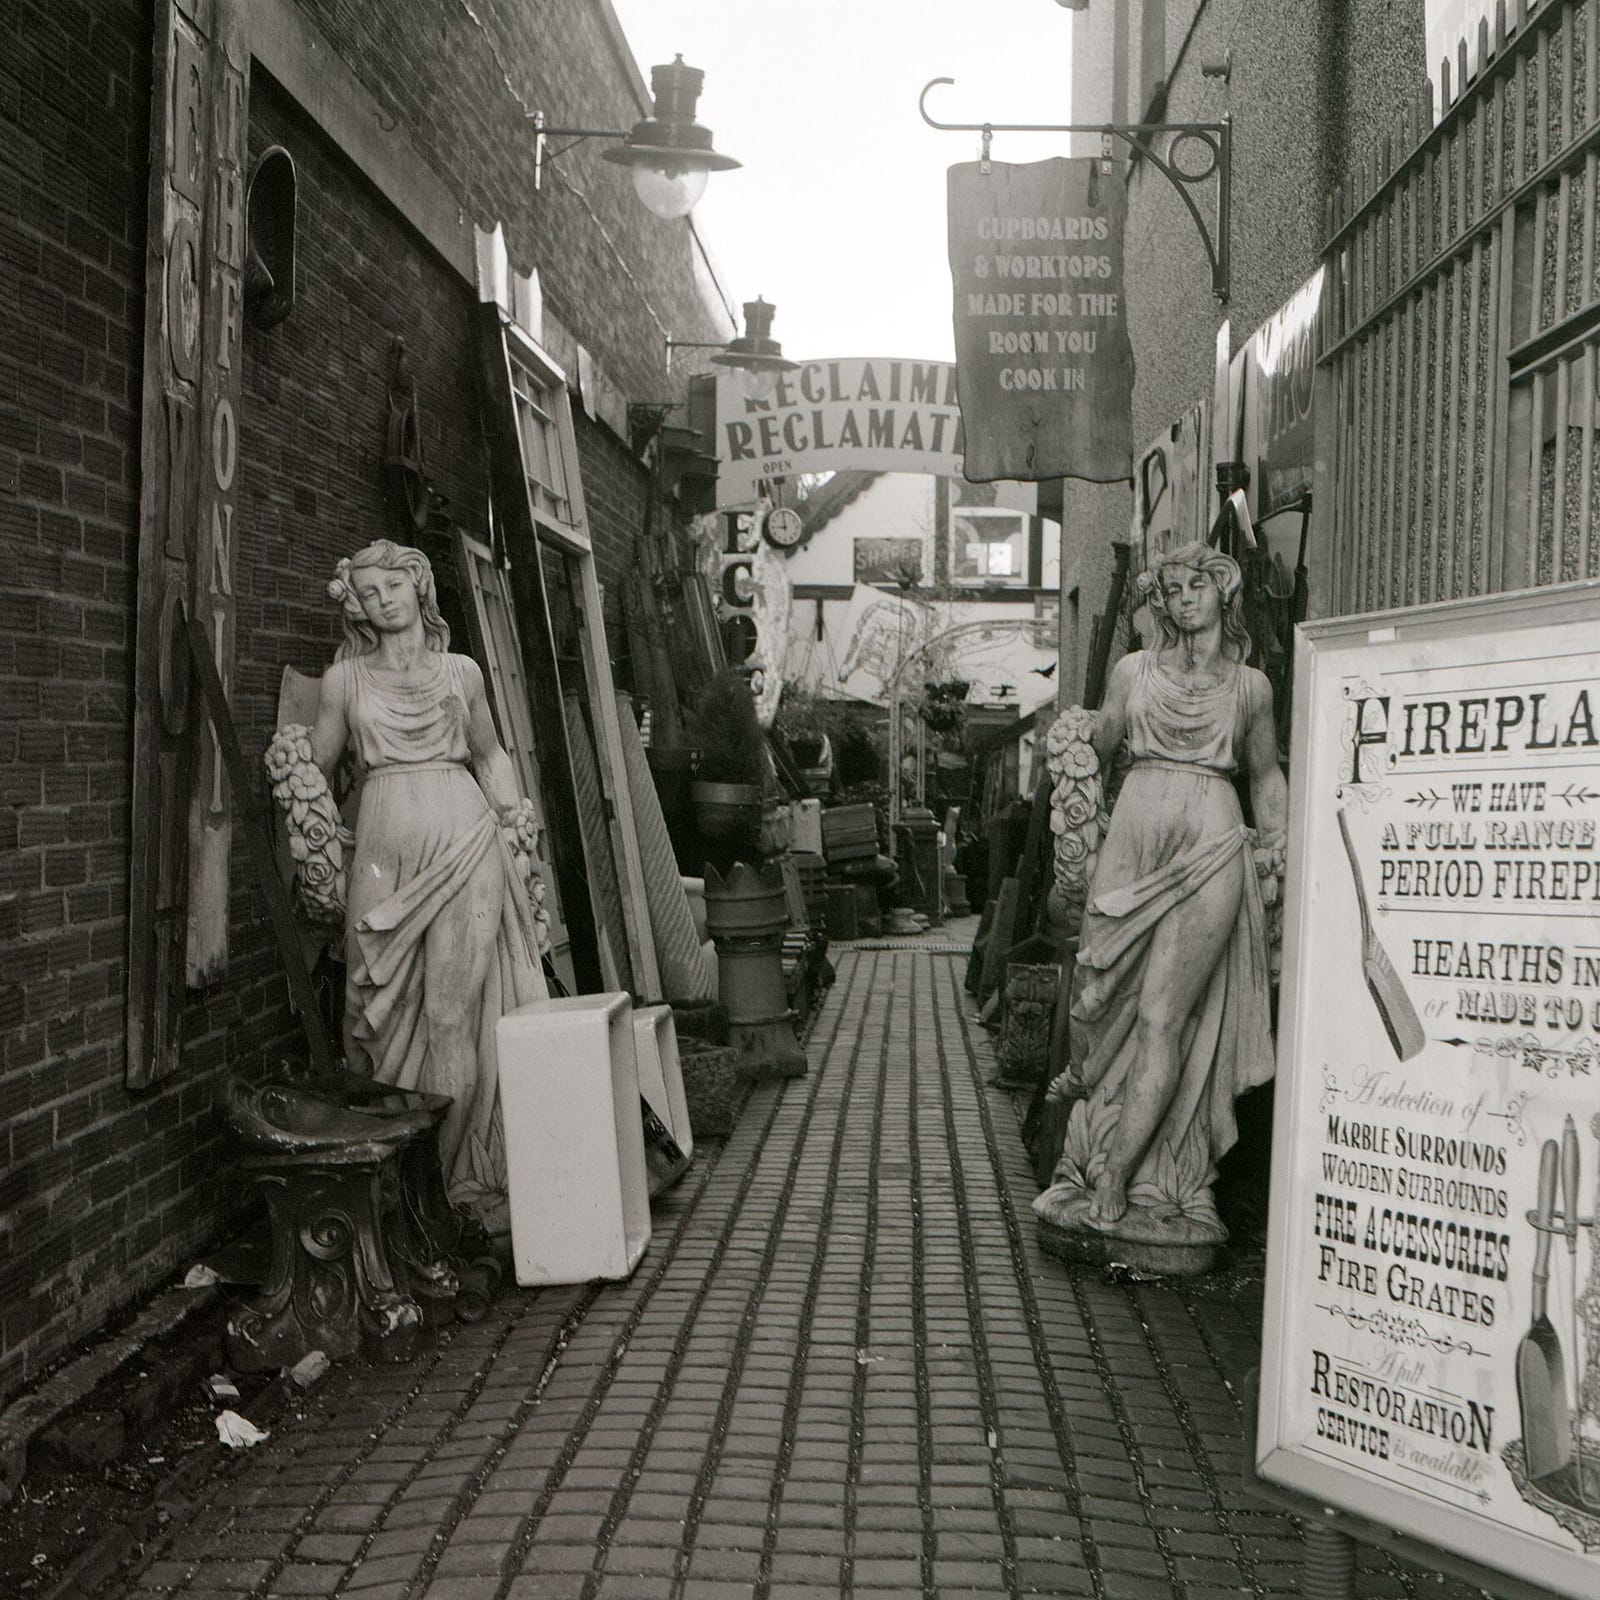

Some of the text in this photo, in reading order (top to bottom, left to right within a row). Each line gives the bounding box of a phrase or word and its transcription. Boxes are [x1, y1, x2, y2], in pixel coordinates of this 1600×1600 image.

[977, 217, 1109, 240] CUPBOARDS
[974, 255, 1112, 279] & WORKTOPS
[967, 293, 1118, 316] MADE FOR THE
[989, 331, 1097, 354] ROOM YOU
[1000, 368, 1086, 391] COOK IN
[763, 460, 791, 474] OPEN
[1342, 688, 1599, 784] FIREPLA
[1452, 781, 1546, 813] WE HAVE
[1381, 819, 1596, 851] A FULL RANGE
[1379, 860, 1483, 898] PERIOD
[1412, 939, 1600, 987] HEARTHS IN
[1424, 997, 1449, 1018] or
[1456, 989, 1537, 1026] MADE
[1544, 995, 1583, 1031] TO
[1346, 1064, 1489, 1134] A selection of
[1327, 1114, 1507, 1176] MARBLE SURROUNDS
[1322, 1152, 1508, 1218] WOODEN SURROUNDS
[1314, 1193, 1510, 1282] FIRE ACCESSORIES
[1318, 1244, 1495, 1326] FIRE GRATES
[1392, 1360, 1425, 1386] full
[1311, 1350, 1495, 1454] RESTORATION
[1317, 1407, 1483, 1484] SERVICE is available
